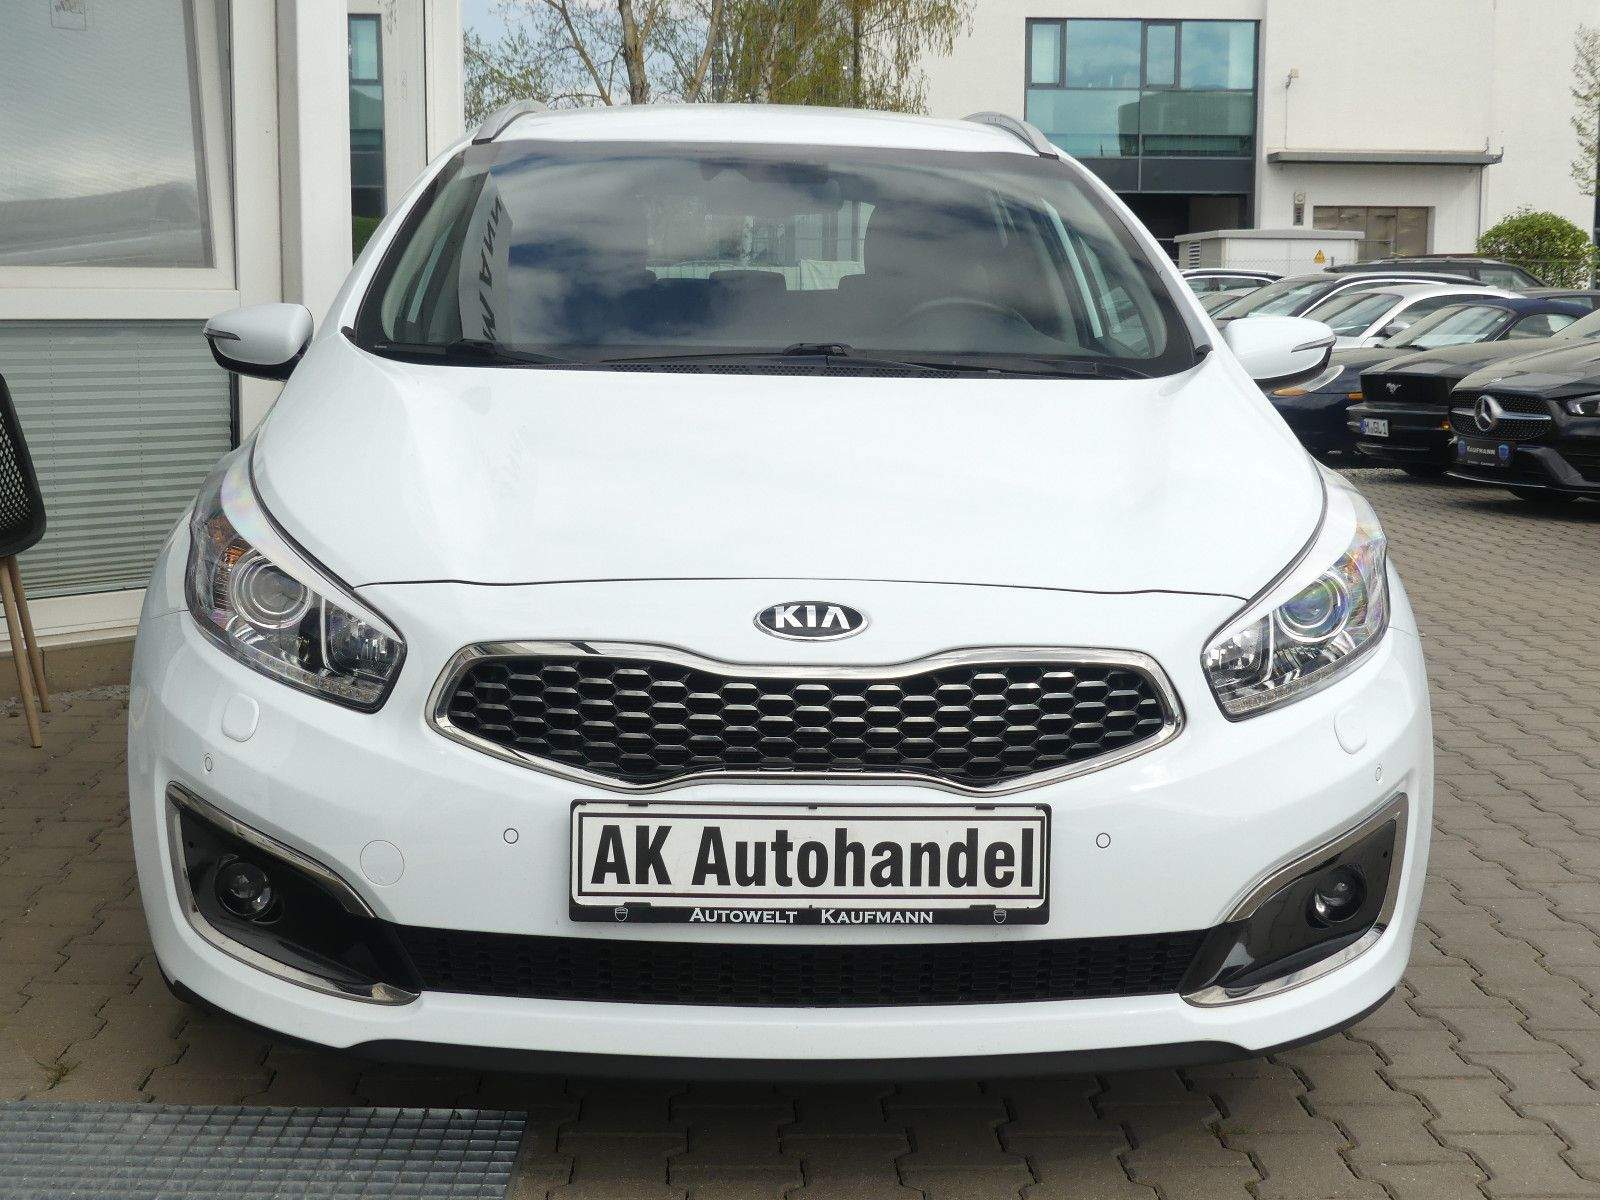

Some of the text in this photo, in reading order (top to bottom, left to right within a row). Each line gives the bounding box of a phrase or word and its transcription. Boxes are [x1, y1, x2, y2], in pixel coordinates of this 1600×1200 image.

[774, 605, 850, 629] KIA
[590, 824, 1034, 888] AK Autohandel
[689, 907, 934, 924] AUTOWELT KAUFMANN
